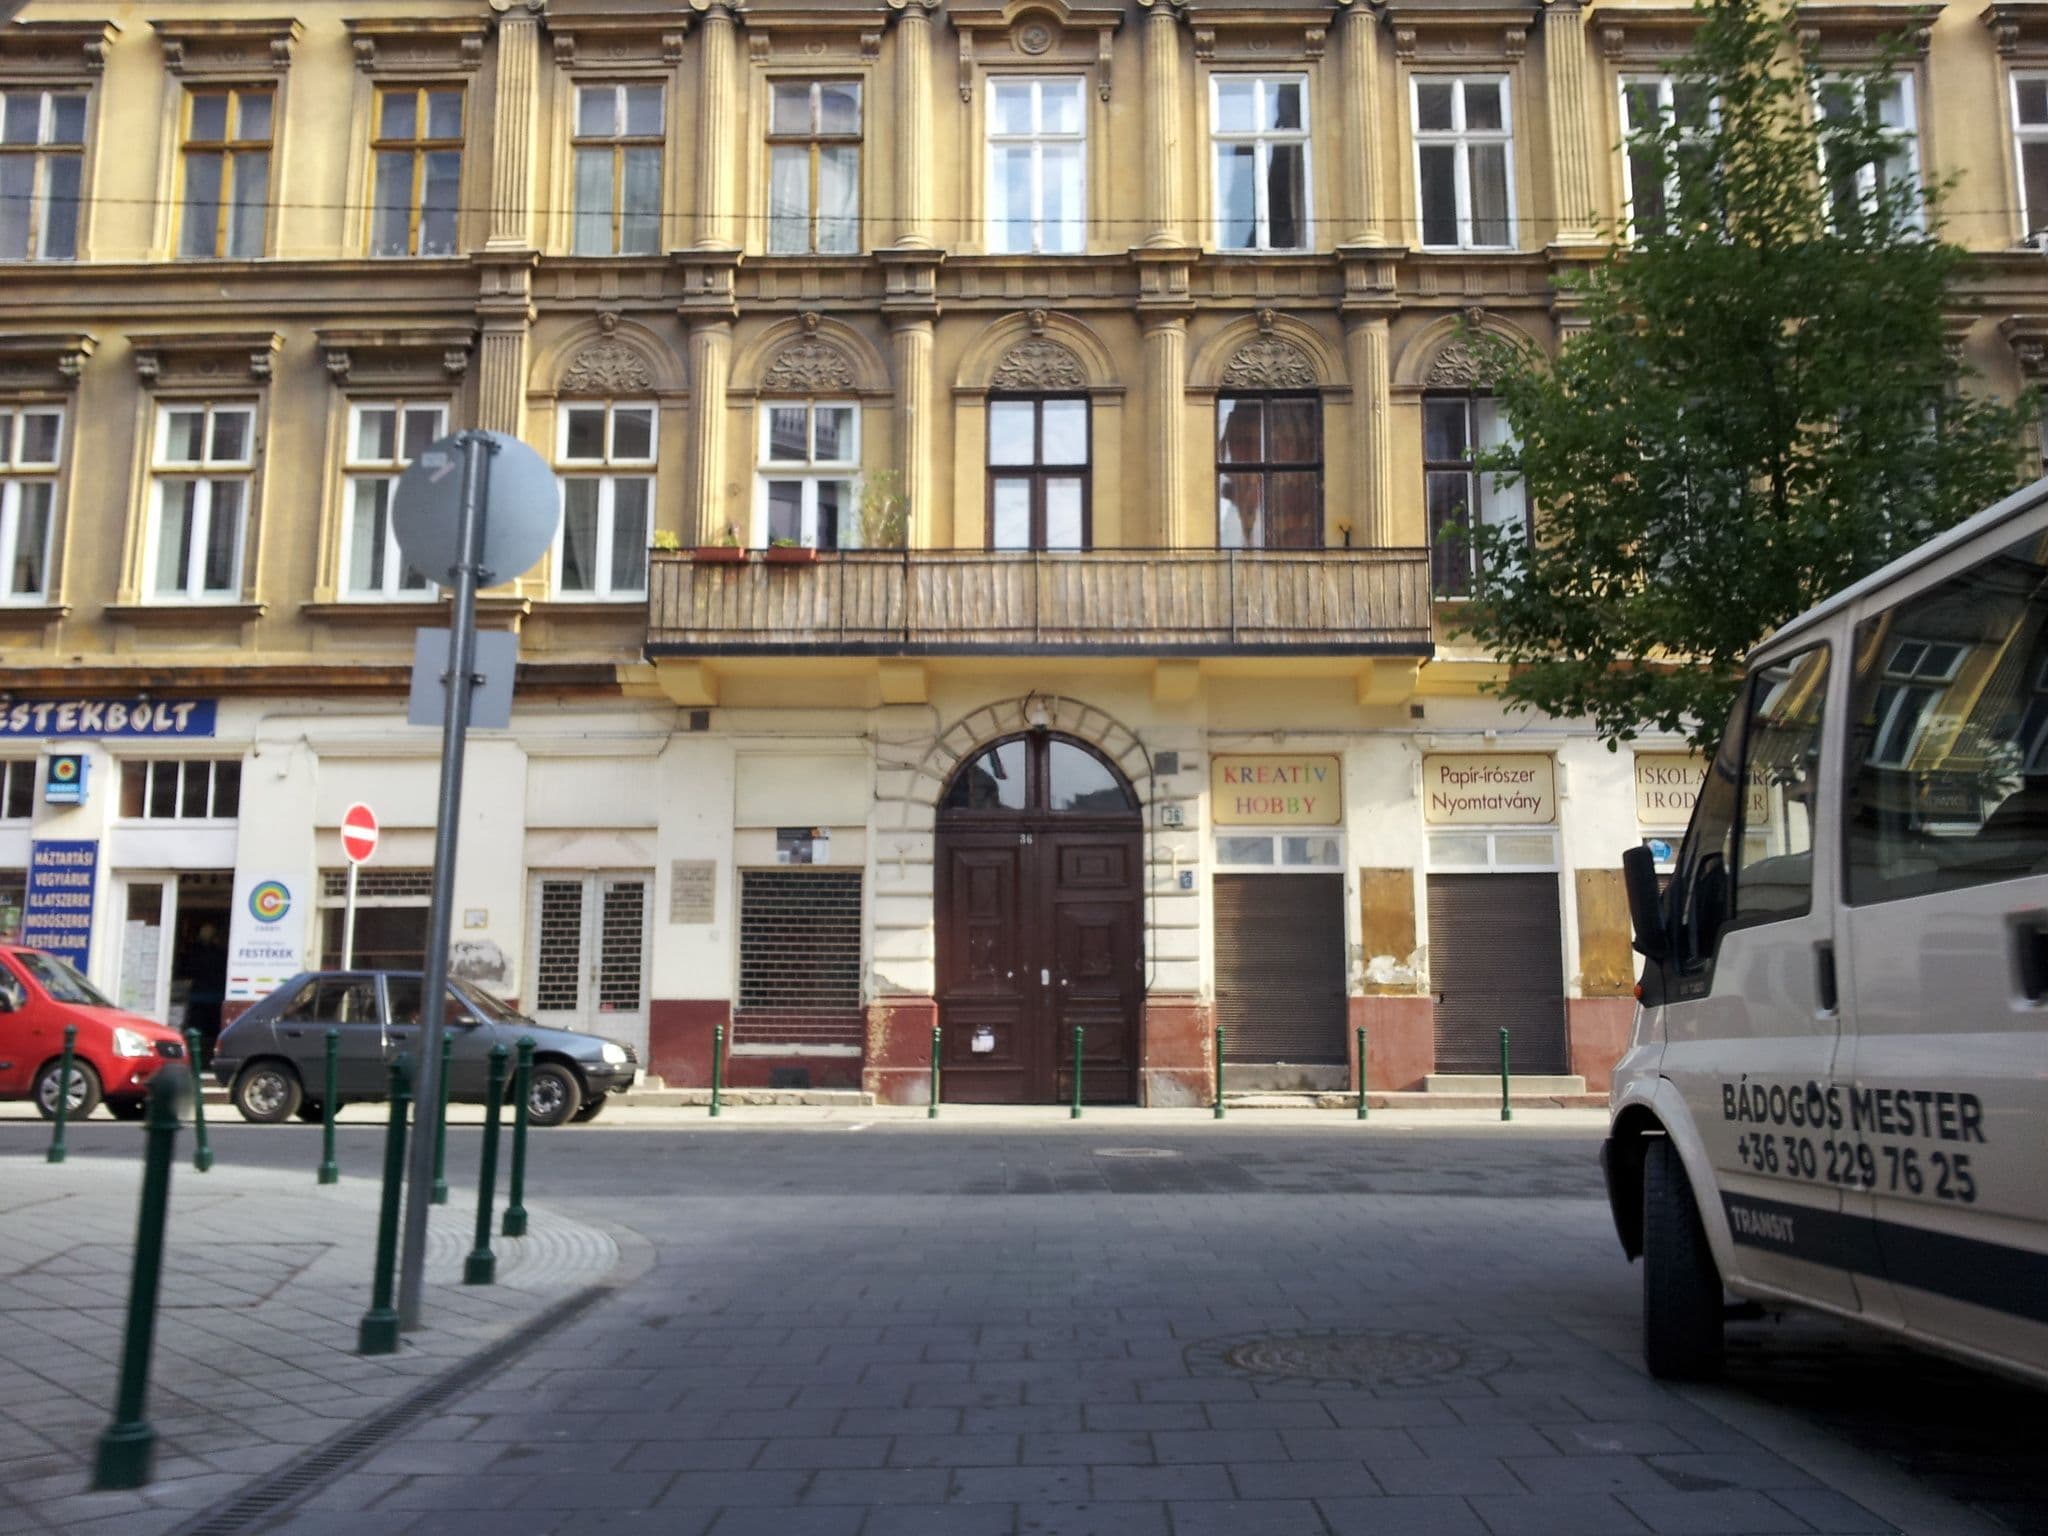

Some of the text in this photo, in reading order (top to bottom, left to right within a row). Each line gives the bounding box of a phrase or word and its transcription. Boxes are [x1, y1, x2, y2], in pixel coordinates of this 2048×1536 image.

[1224, 763, 1327, 784] KREATÍV
[1440, 764, 1536, 787] Papír-írószer
[1236, 797, 1317, 815] HOBBY
[1433, 792, 1541, 817] Nyomtatvány
[1019, 833, 1033, 845] 36
[34, 848, 94, 867] HÁZTARTÁSI
[35, 870, 90, 887] VEGYIÁRUK
[30, 893, 90, 908] ILLATSZEREK
[239, 947, 293, 959] FESTÉKEK
[1722, 1073, 1987, 1144] BÁDOGOS MESTER
[1738, 1133, 1976, 1203] +36 30 229 76 25
[1731, 1208, 1795, 1242] TRANSIT
